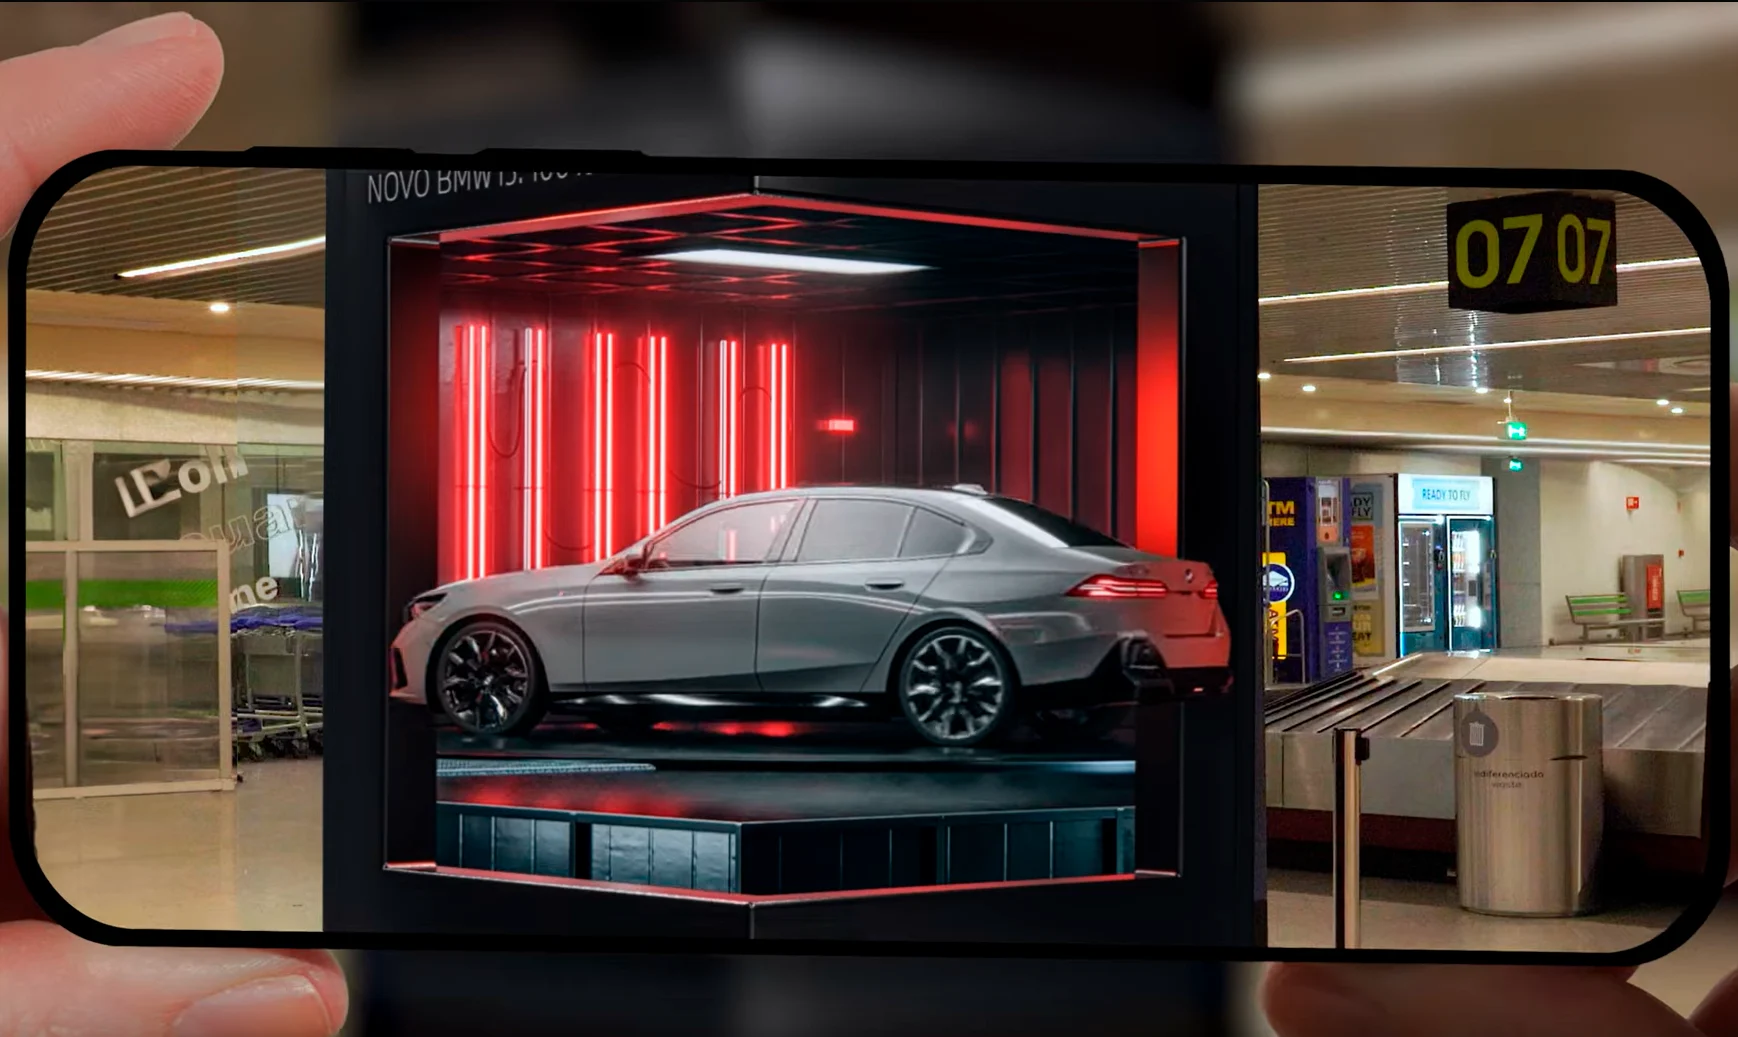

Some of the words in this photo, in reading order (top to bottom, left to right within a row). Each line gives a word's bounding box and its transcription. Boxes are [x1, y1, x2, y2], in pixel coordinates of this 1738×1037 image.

[368, 169, 430, 204] NOVO
[437, 170, 492, 194] BMW
[1455, 213, 1543, 289] 07
[1557, 213, 1612, 285] 07
[1268, 501, 1295, 515] TM
[1421, 488, 1447, 501] READY
[1448, 489, 1458, 501] TO
[1460, 490, 1472, 501] FLY
